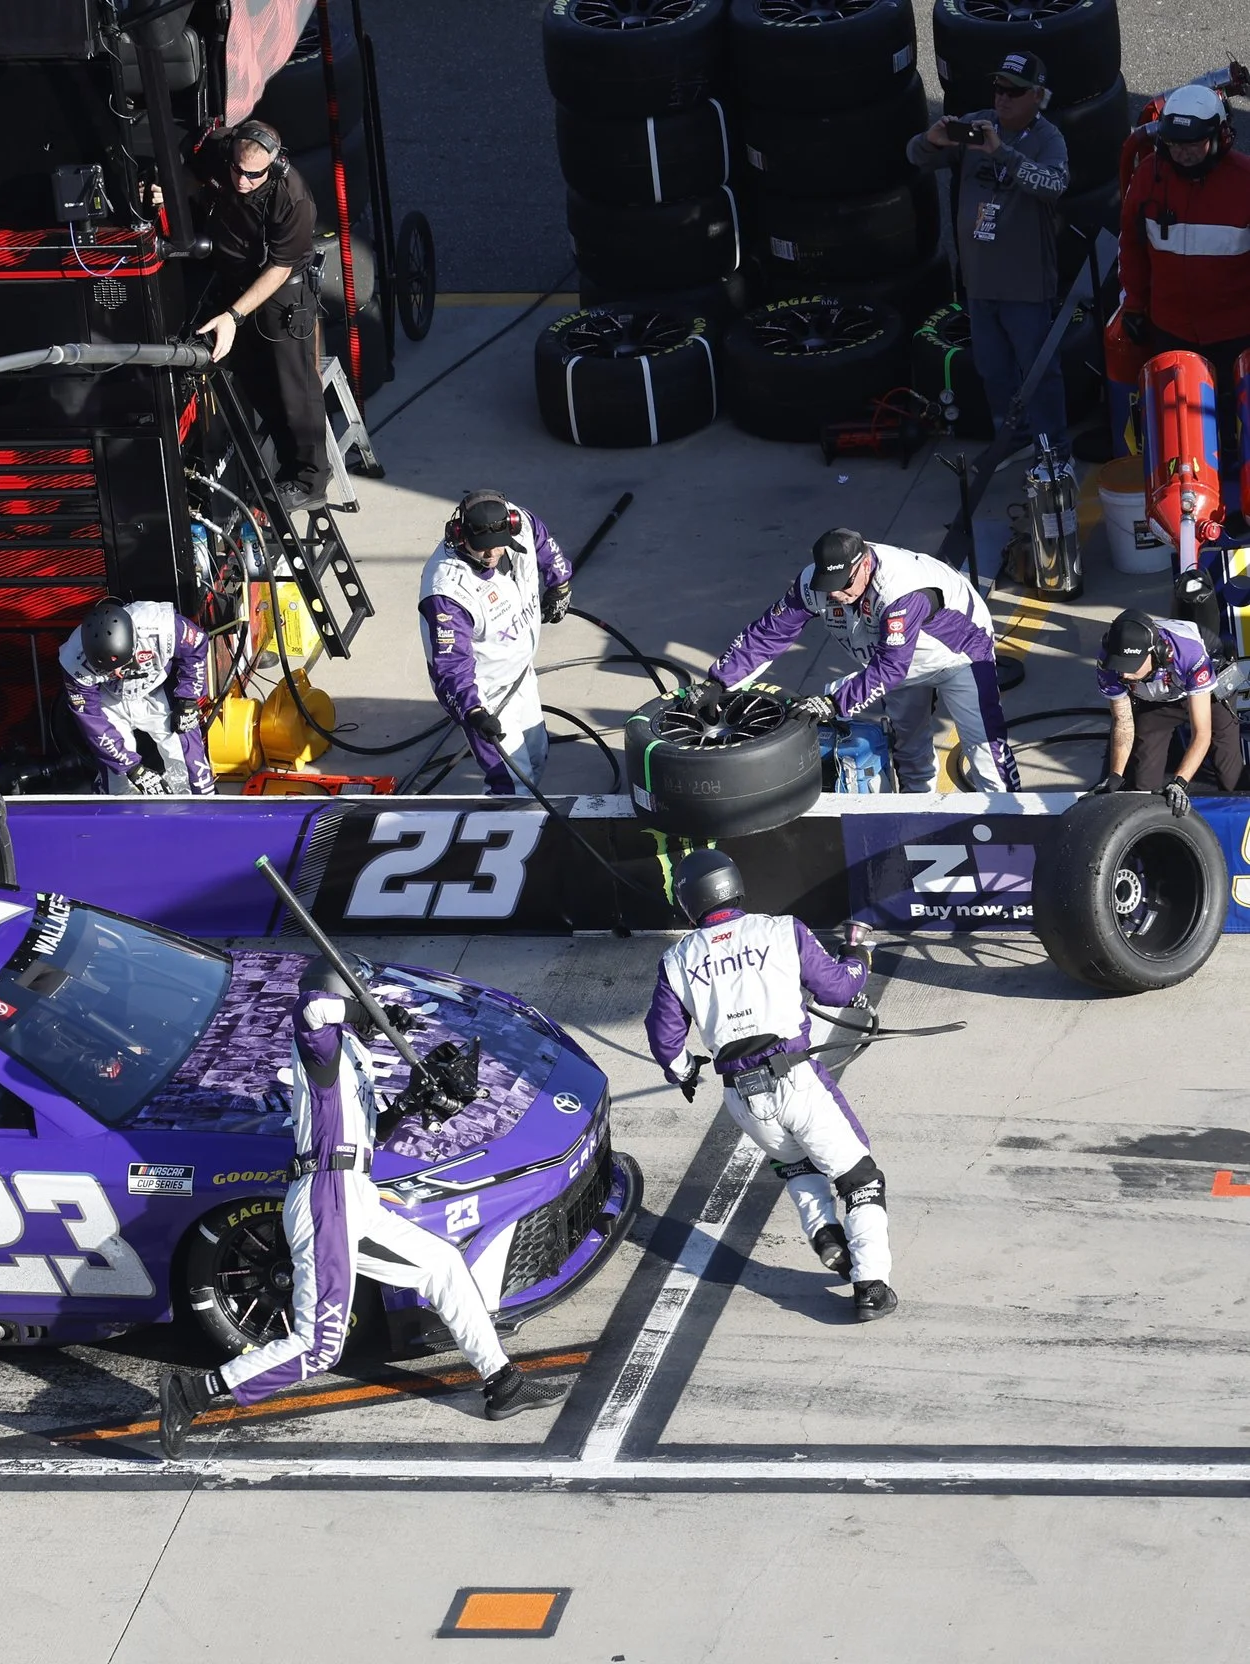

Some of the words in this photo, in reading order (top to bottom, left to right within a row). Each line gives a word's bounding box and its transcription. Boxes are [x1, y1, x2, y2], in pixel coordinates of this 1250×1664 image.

[549, 308, 590, 333] EAGLE
[766, 294, 823, 312] EAGLE
[497, 593, 539, 642] xfinit
[1123, 647, 1143, 655] xfinity
[192, 660, 206, 696] xfinit
[847, 682, 887, 718] xfinity
[97, 733, 134, 767] xfinity
[343, 810, 550, 920] 23
[31, 892, 71, 956] WALLACE
[910, 903, 952, 920] Buy
[956, 905, 1010, 919] now,
[1013, 905, 1034, 919] pa
[686, 945, 770, 987] xfinity
[726, 1011, 745, 1021] Mobil
[137, 1179, 154, 1189] CUP
[154, 1180, 184, 1190] SERIES
[148, 1166, 186, 1178] NASCAR
[445, 1194, 481, 1235] 23
[299, 1301, 347, 1380] xfinity
